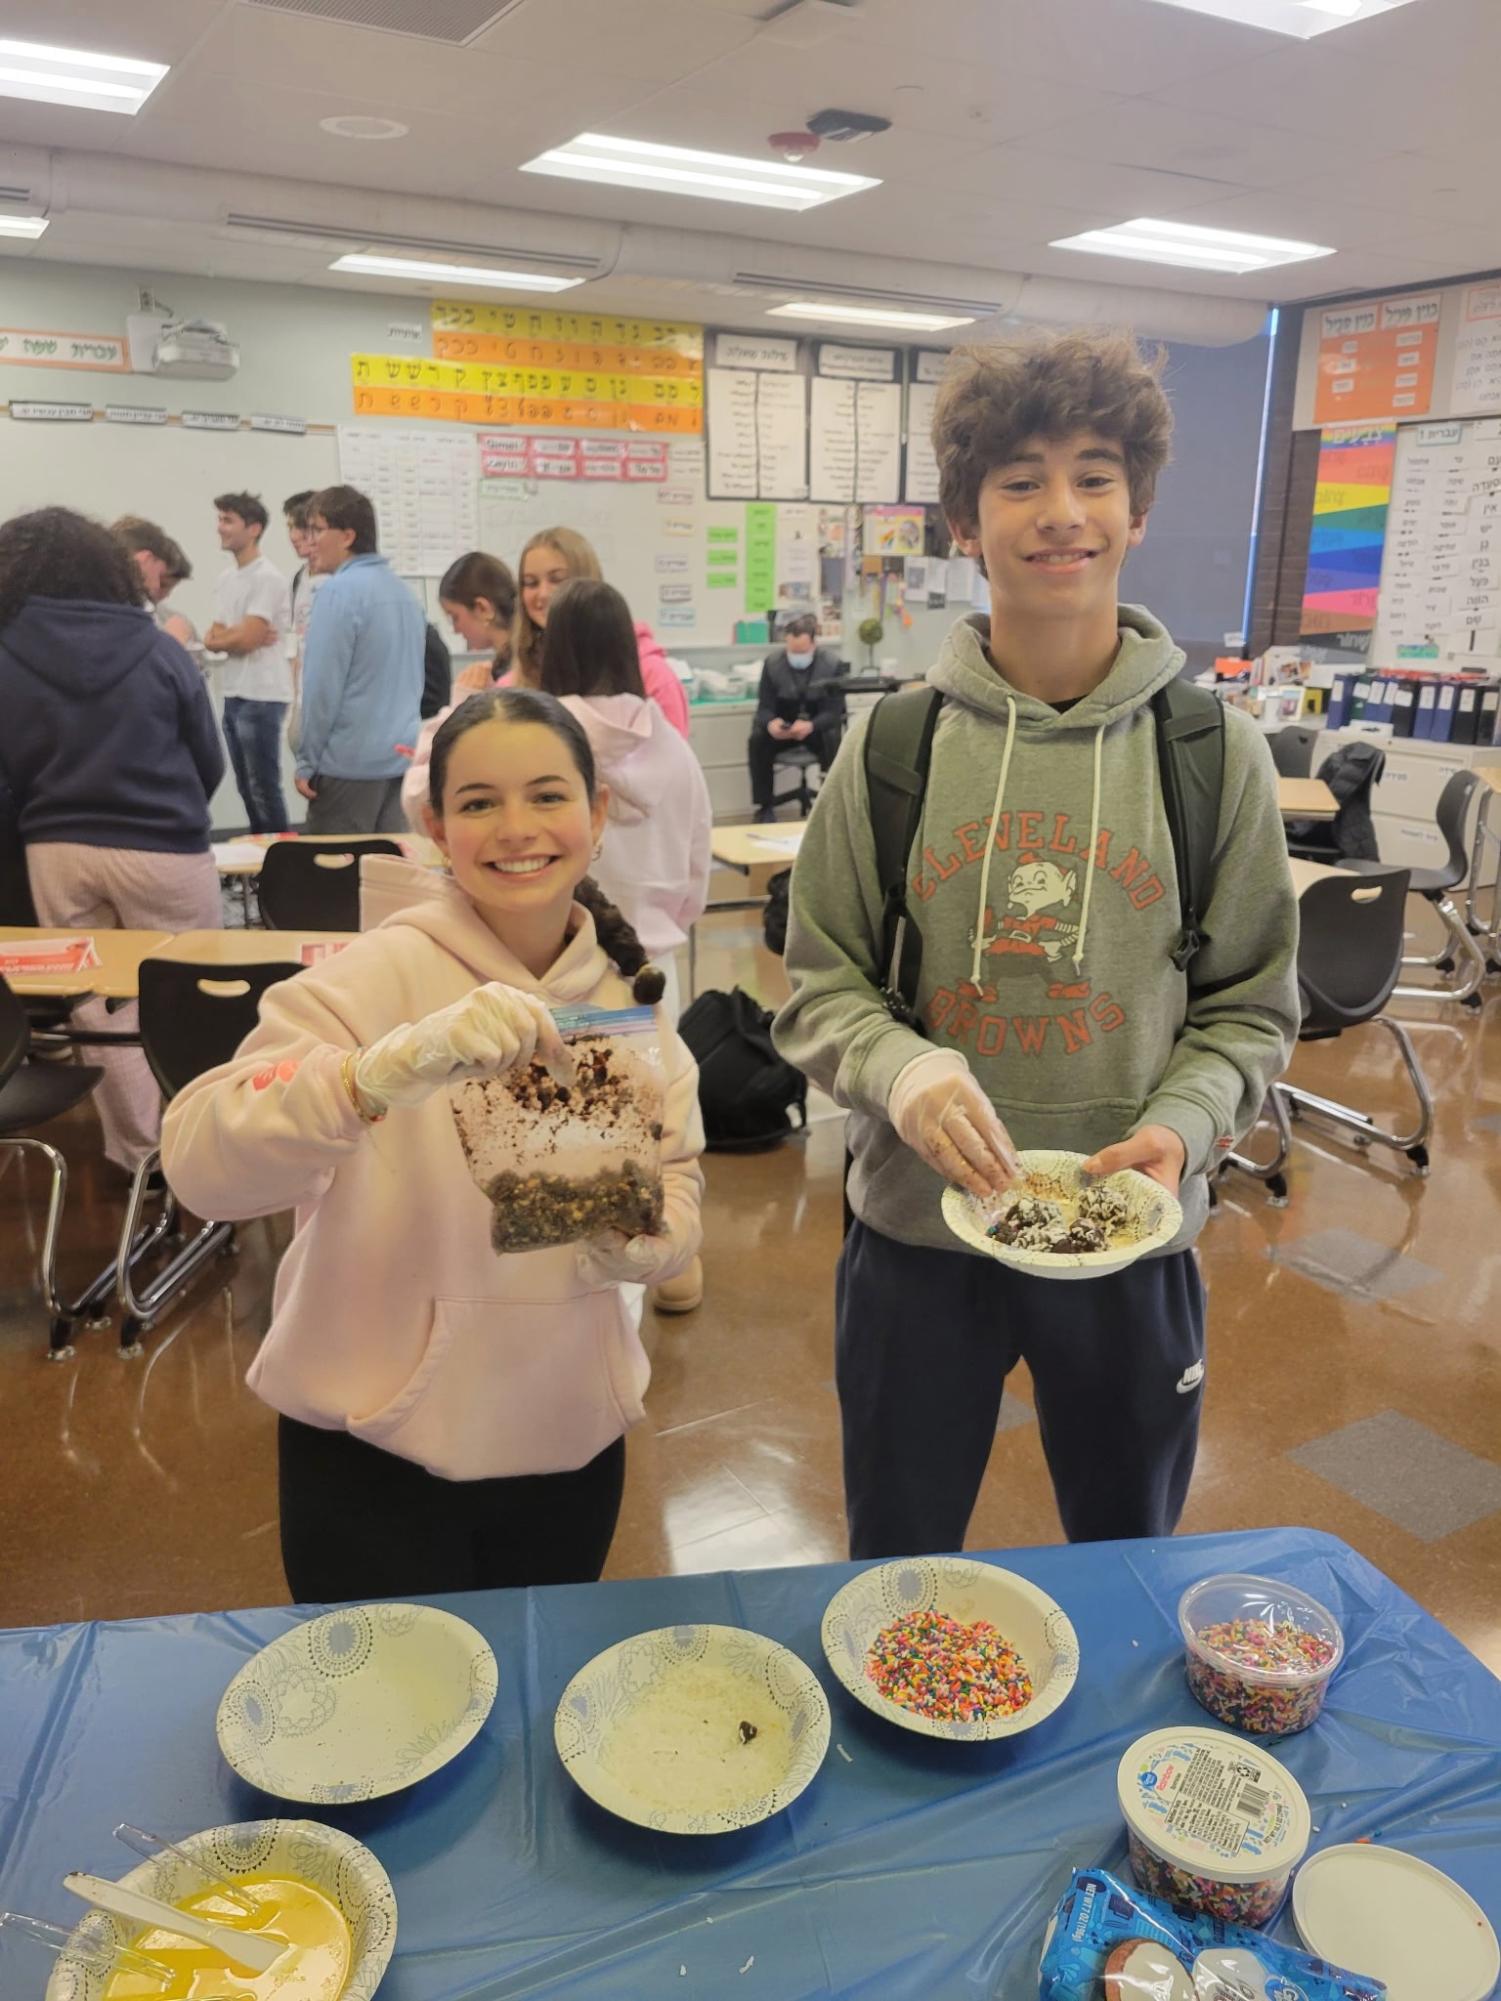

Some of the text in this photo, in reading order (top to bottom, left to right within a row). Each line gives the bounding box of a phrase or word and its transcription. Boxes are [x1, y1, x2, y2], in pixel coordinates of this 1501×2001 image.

[911, 809, 1167, 911] CLEVELAND
[926, 984, 1126, 1057] BROWNS
[1085, 1883, 1097, 1898] NET
